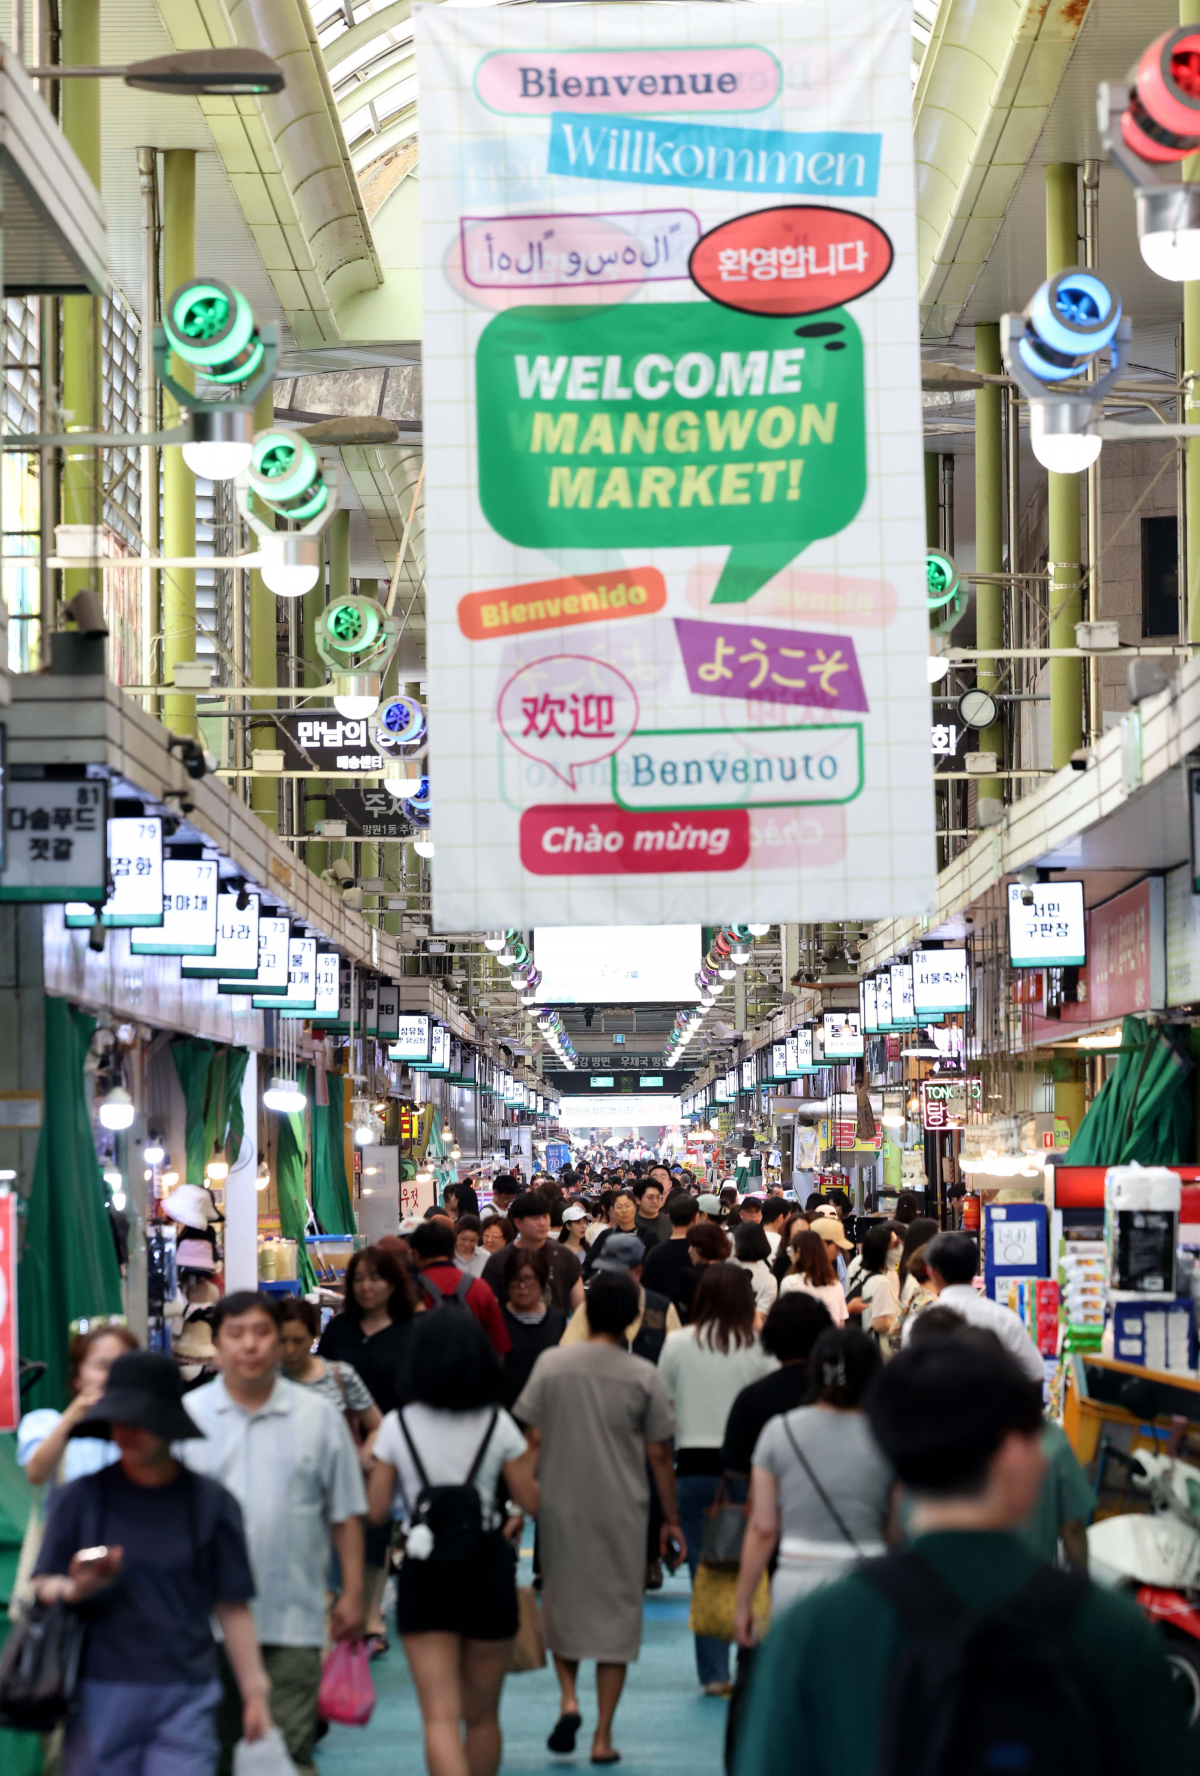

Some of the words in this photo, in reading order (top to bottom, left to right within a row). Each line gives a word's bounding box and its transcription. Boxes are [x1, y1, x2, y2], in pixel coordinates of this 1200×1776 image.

[519, 68, 738, 98] Bienvenue
[561, 124, 866, 187] Willkommen
[717, 241, 868, 283] 환영합니다
[514, 348, 805, 400] WELCOME
[530, 402, 838, 455] MANGWON
[547, 459, 805, 509] MARKET!
[481, 583, 648, 628] Bienvenido
[698, 636, 849, 696] ようこそ
[521, 693, 617, 739] 欢迎
[298, 721, 366, 747] 만남의
[632, 754, 838, 786] Benvenuto
[77, 787, 98, 805] 81
[138, 825, 156, 838] 79
[541, 824, 625, 854] Chào
[633, 823, 730, 855] mừng
[29, 838, 73, 862] 젓갈
[196, 867, 212, 880] 77
[1033, 902, 1060, 918] 서민
[272, 922, 286, 933] 73
[1025, 923, 1069, 938] 구판장
[300, 942, 312, 952] 71
[915, 952, 926, 963] 78
[324, 957, 337, 967] 69
[919, 971, 966, 984] 서울축산
[591, 1056, 610, 1067] 방면
[620, 1056, 648, 1067] 우체국
[822, 1176, 846, 1185] 고려
